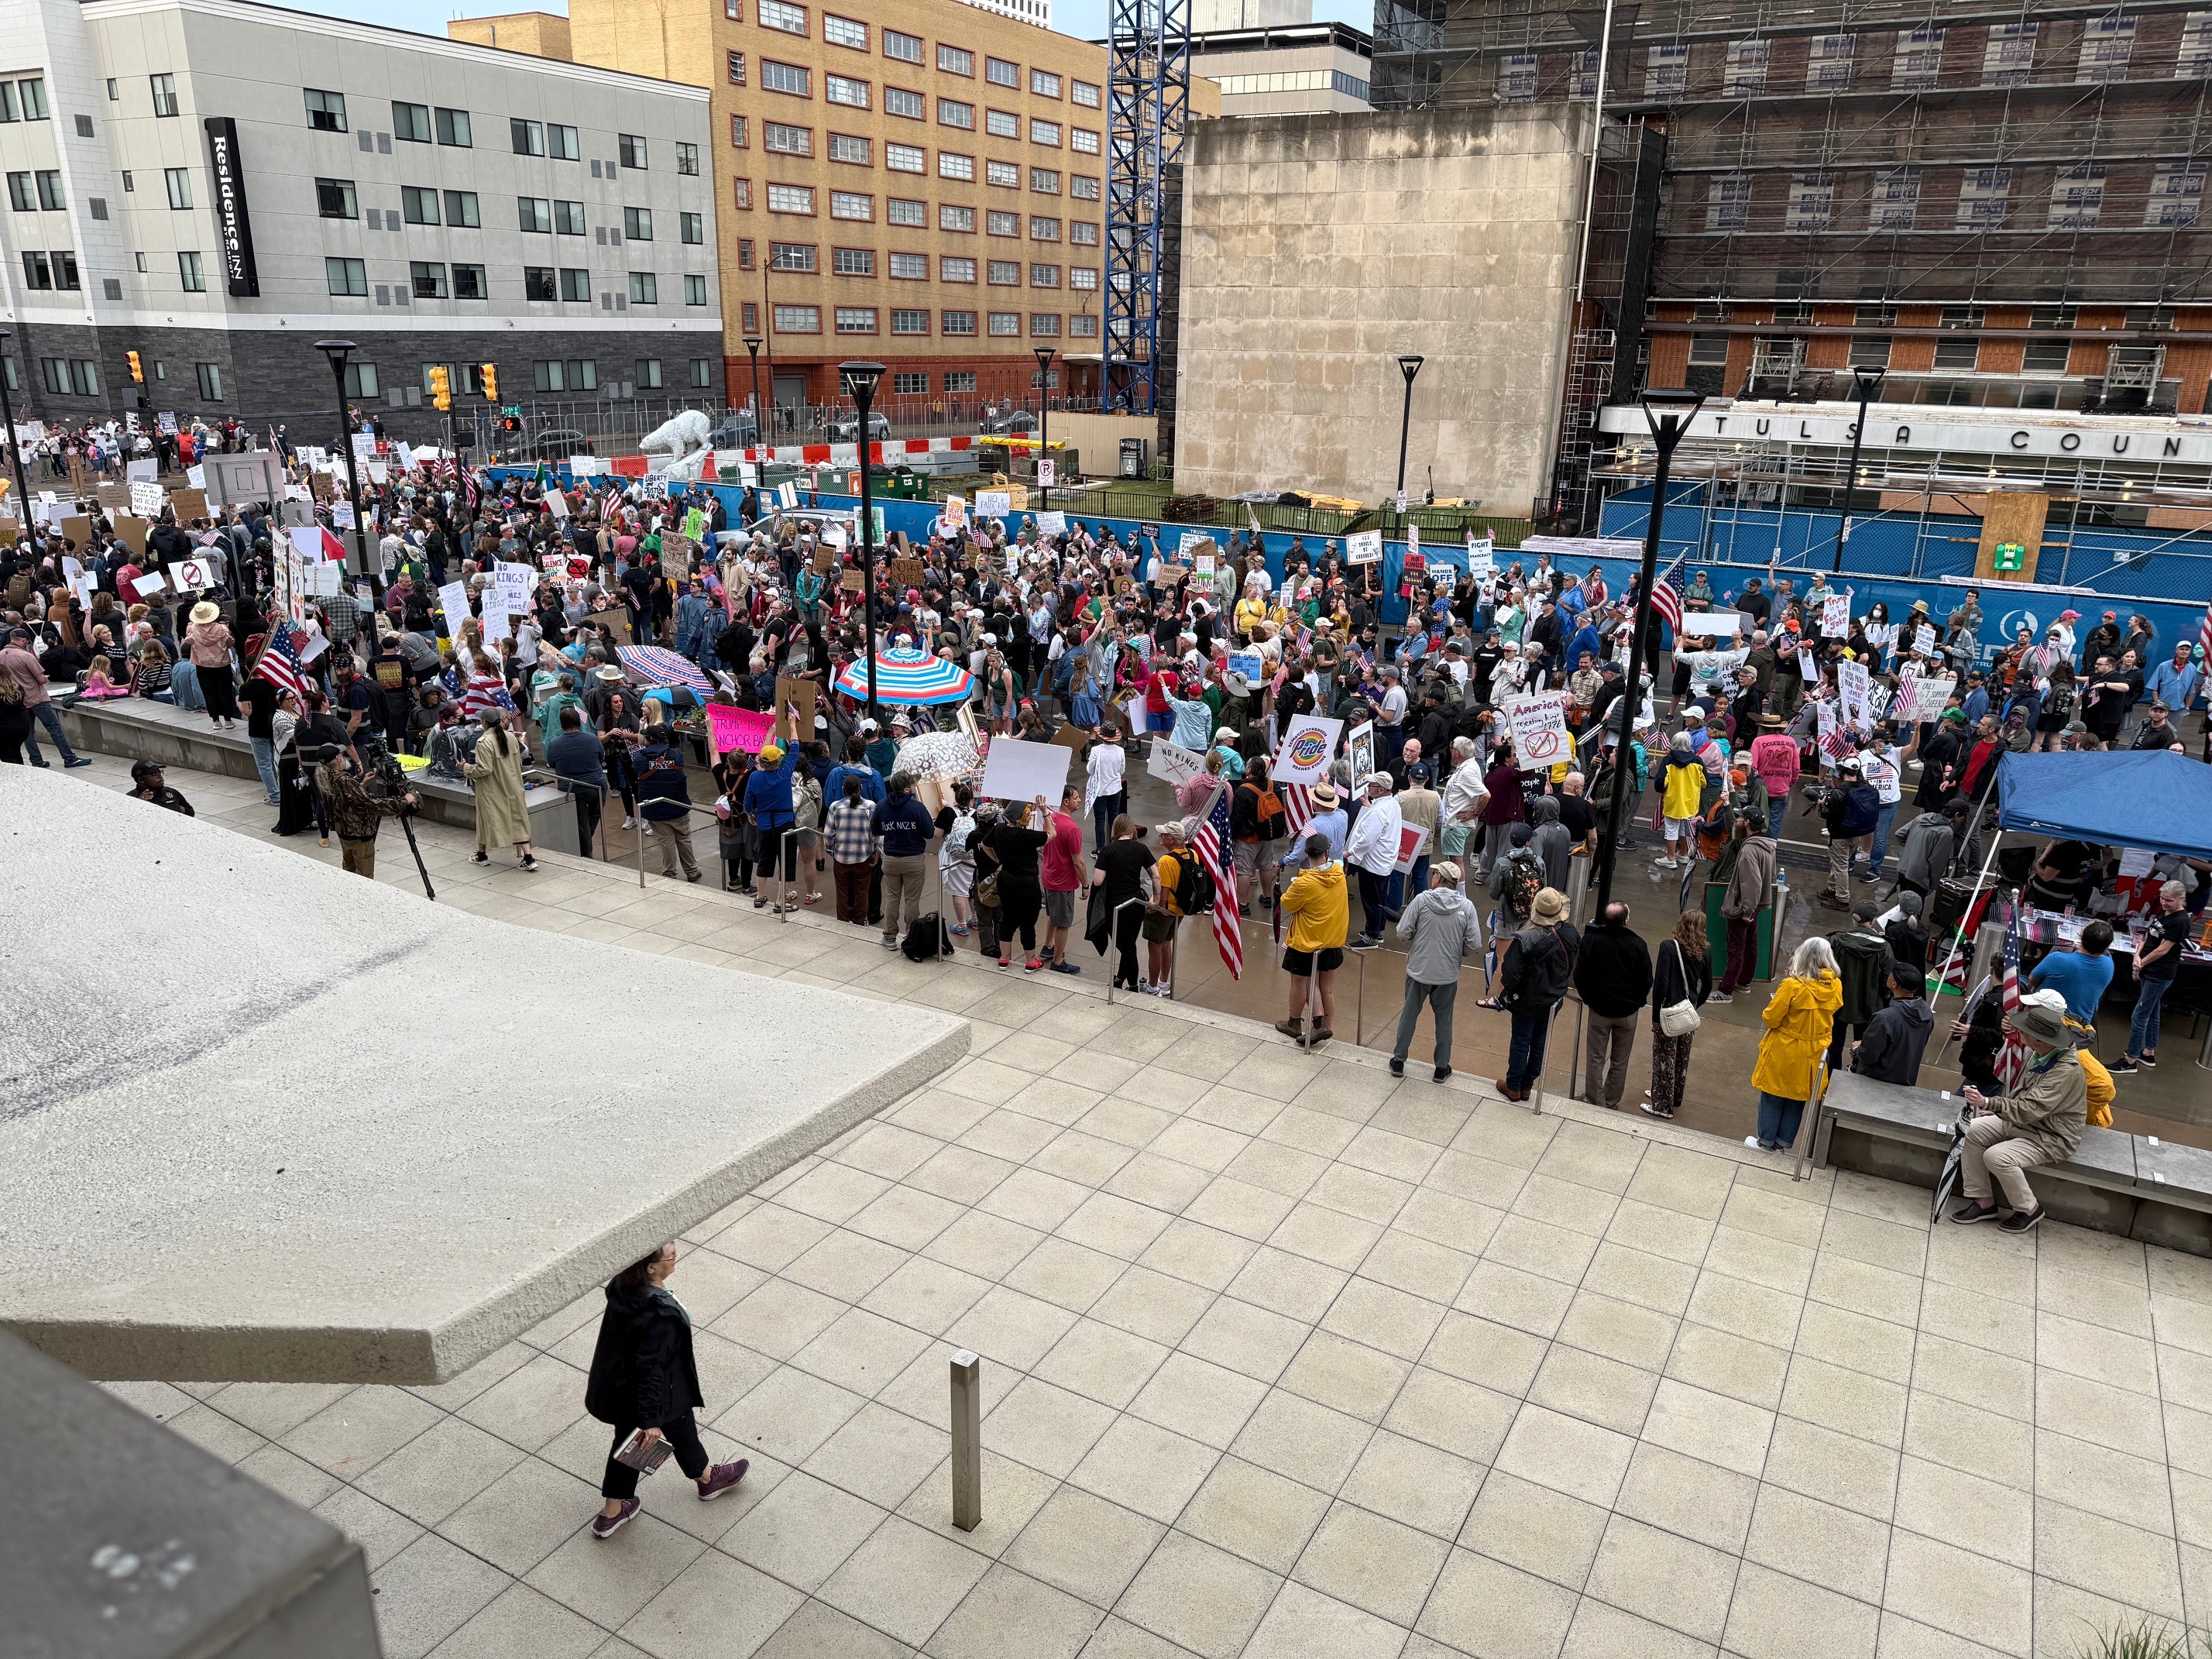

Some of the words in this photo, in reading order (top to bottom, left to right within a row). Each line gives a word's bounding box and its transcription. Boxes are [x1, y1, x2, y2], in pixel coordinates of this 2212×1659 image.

[215, 136, 239, 250] Residence
[232, 255, 243, 280] INN
[223, 227, 232, 236] BY
[225, 239, 235, 280] MARRIOTT
[1715, 417, 1911, 445] TULSA
[988, 494, 998, 503] NO
[948, 507, 963, 516] NEVER
[948, 512, 963, 521] KING
[498, 563, 508, 572] NO
[893, 561, 906, 572] NO
[1160, 565, 1181, 575] Freedom
[496, 573, 524, 583] KINGS
[894, 574, 906, 583] NO
[489, 590, 498, 601] NO
[779, 588, 791, 597] THY
[485, 598, 505, 611] KINGS
[1513, 700, 1561, 716] America
[714, 718, 743, 730] TRUMP
[747, 720, 757, 731] IS
[1516, 717, 1544, 729] rejecting
[1544, 710, 1560, 721] kings
[1541, 720, 1561, 730] 1776
[713, 733, 752, 747] ANCHOR
[1289, 739, 1328, 758] Pride
[1162, 748, 1172, 757] NO
[1174, 752, 1199, 771] KINGS
[881, 821, 895, 831] FUCK
